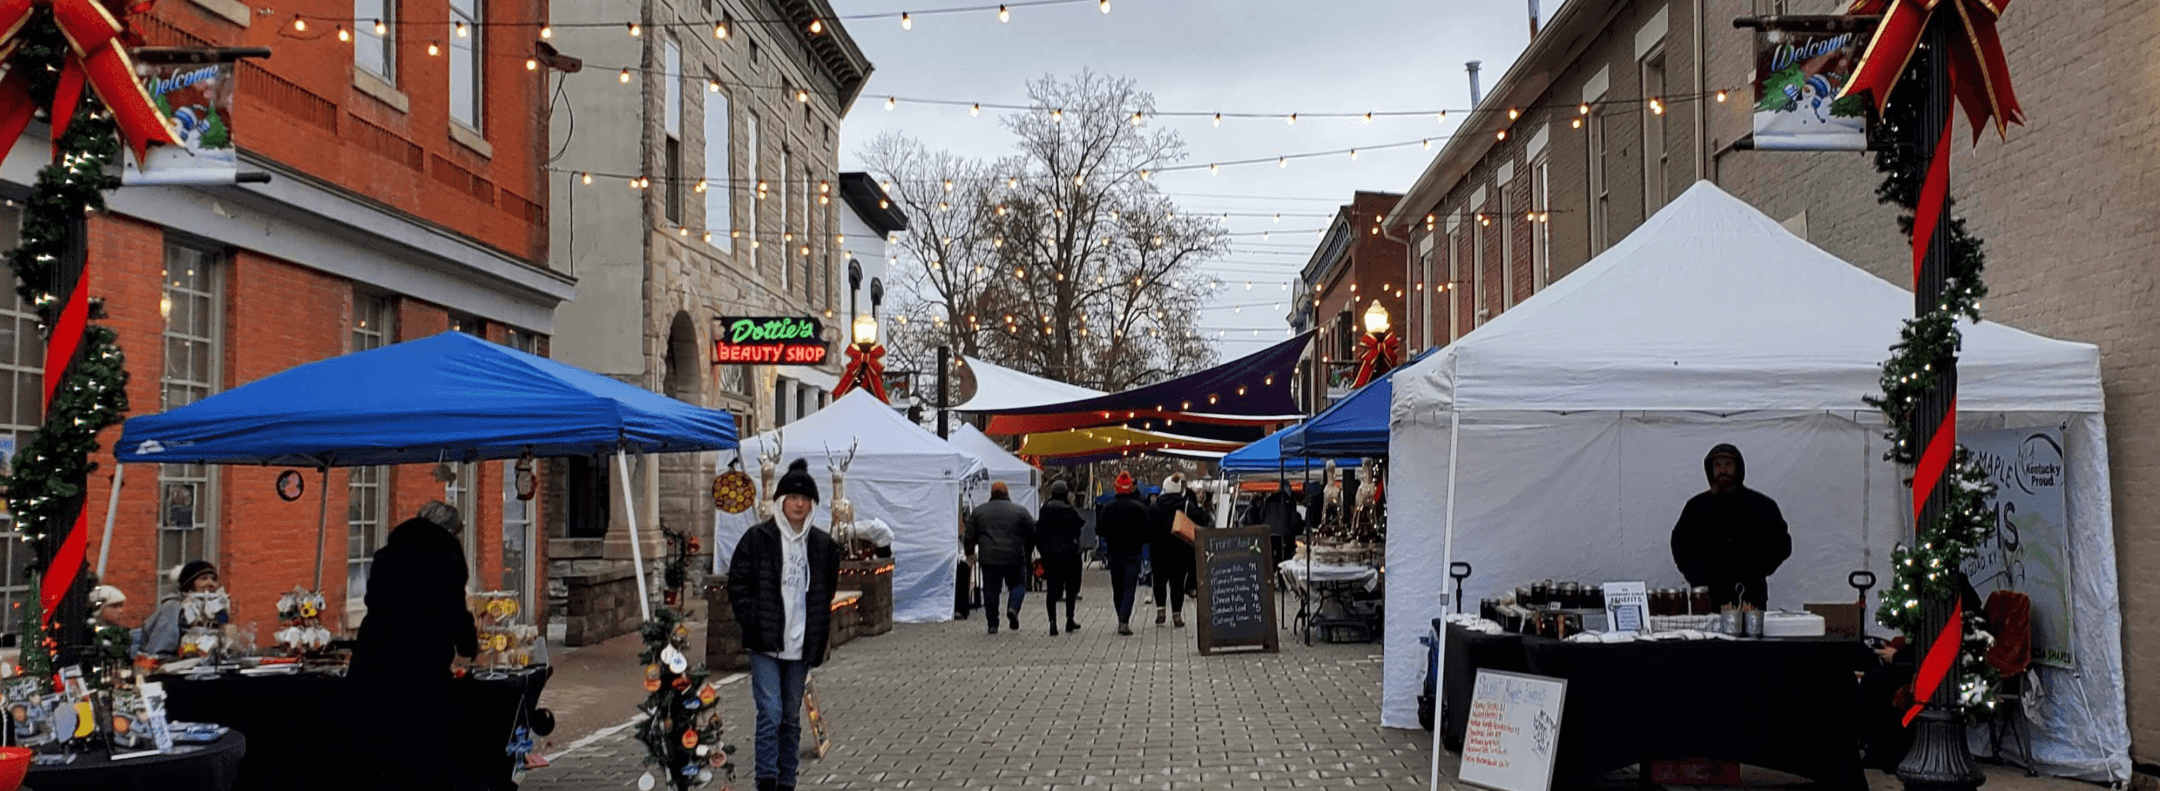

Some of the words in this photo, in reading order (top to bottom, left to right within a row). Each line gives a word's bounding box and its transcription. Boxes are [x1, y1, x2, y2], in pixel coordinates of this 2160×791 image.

[1771, 32, 1852, 72] Welcome
[718, 342, 784, 362] BEAUTY
[785, 345, 826, 362] SHOP
[1978, 450, 2013, 489] MAPLE
[2025, 462, 2061, 477] Kentucky
[2031, 475, 2055, 487] Proud
